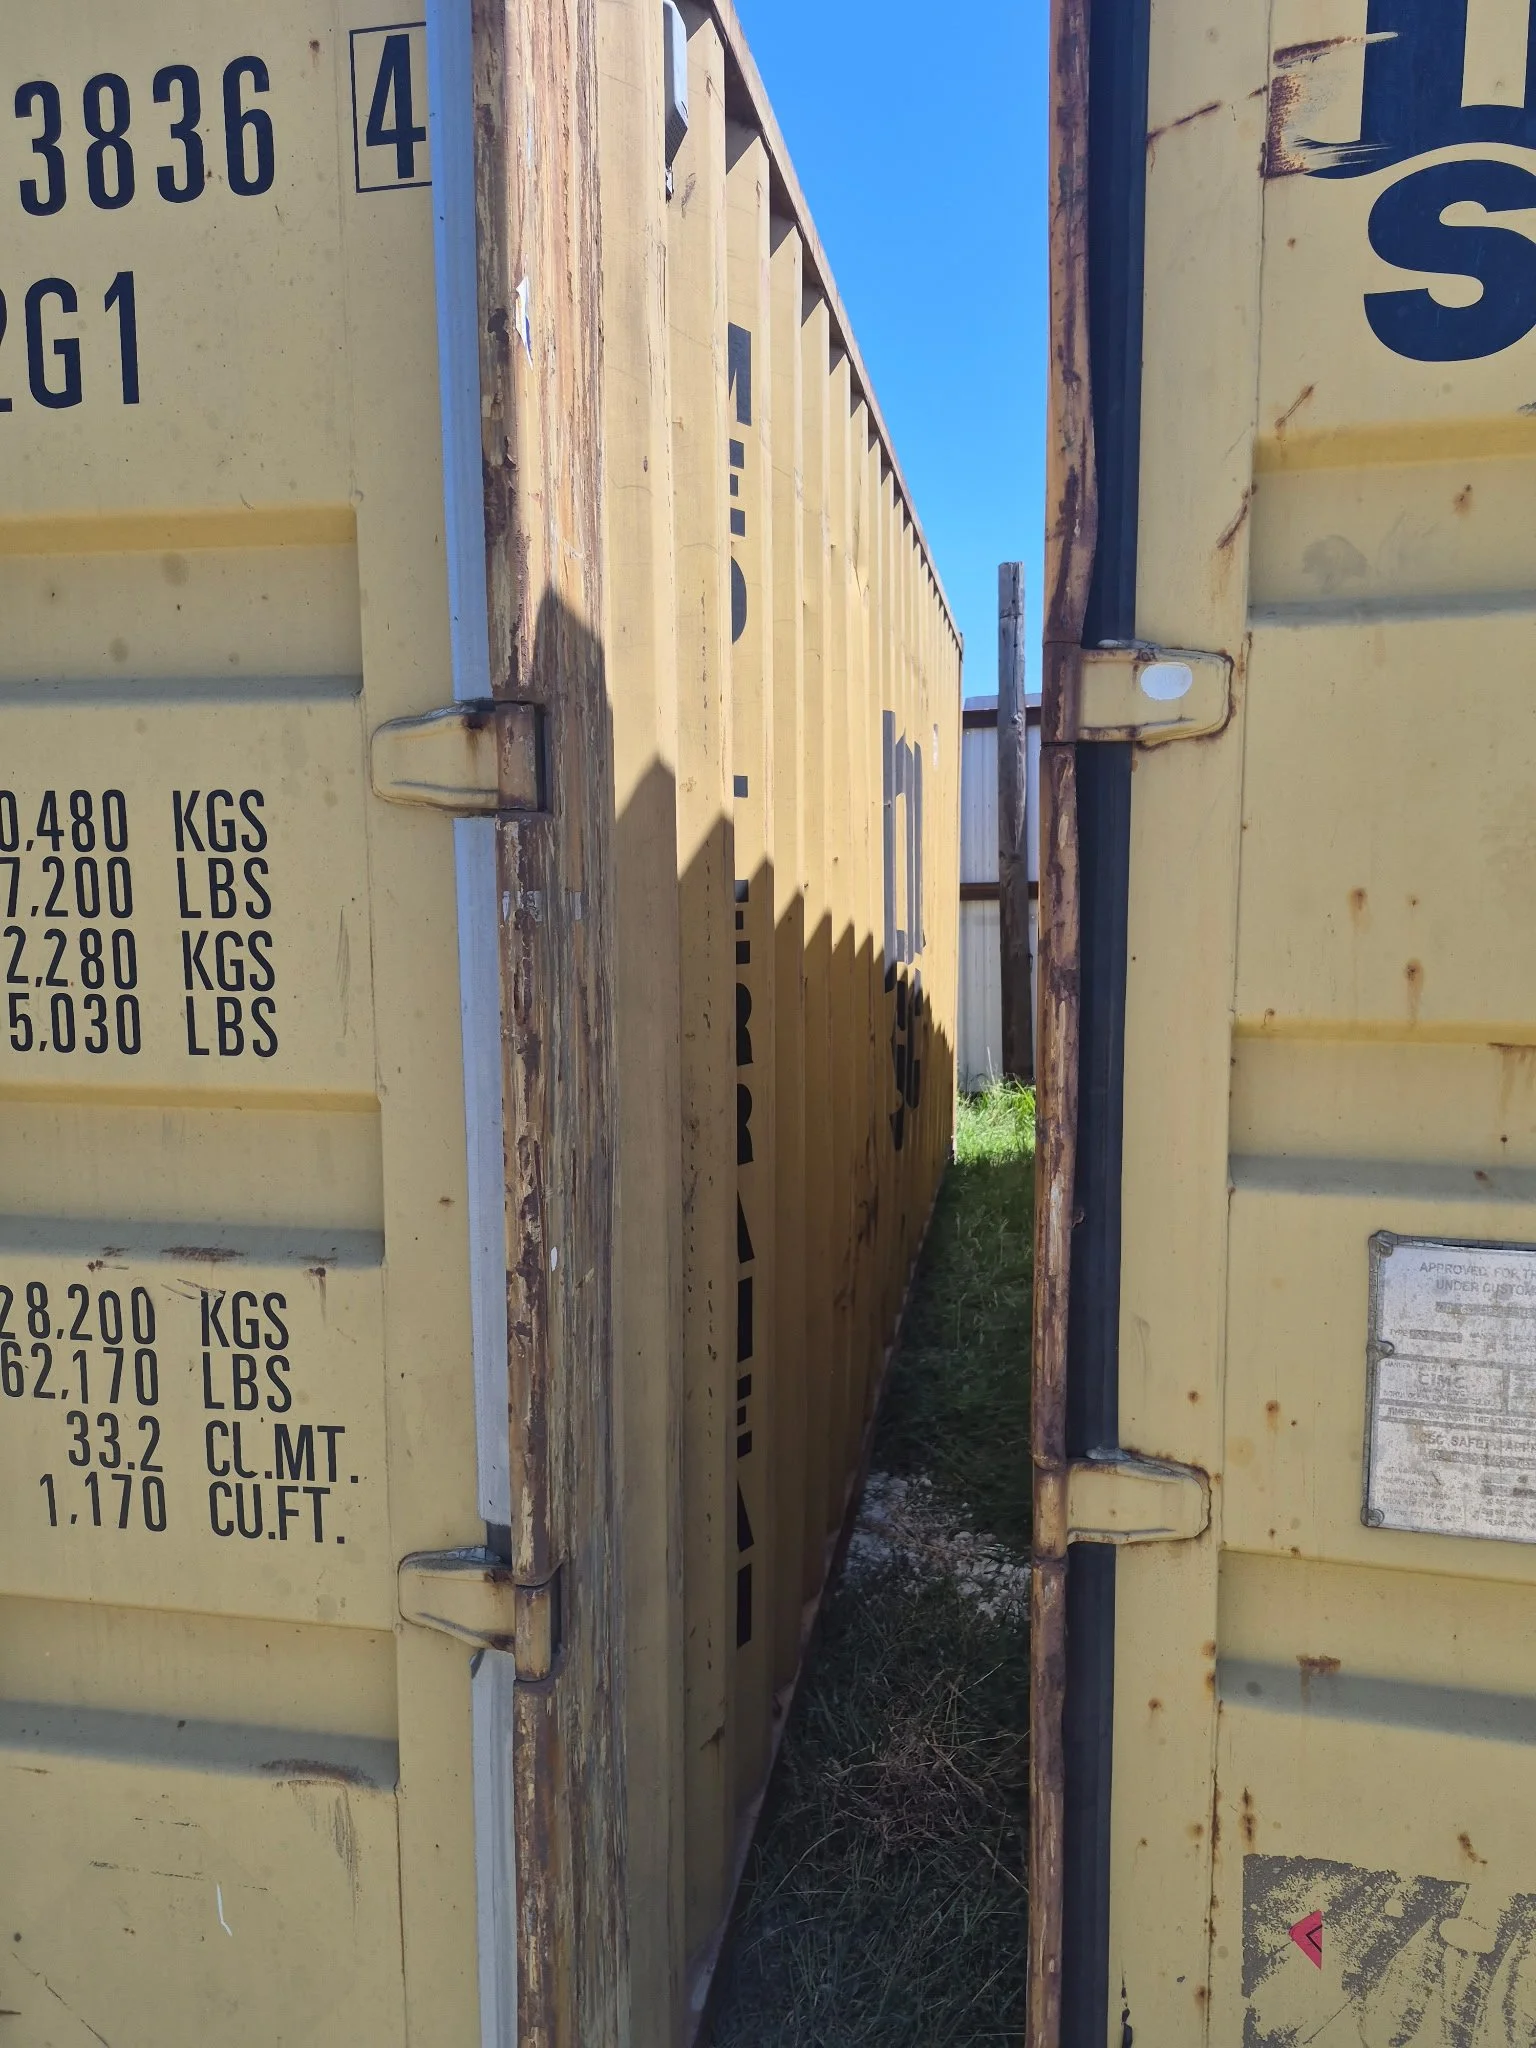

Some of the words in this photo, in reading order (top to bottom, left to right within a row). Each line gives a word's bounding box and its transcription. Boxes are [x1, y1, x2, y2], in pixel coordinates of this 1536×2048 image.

[15, 56, 274, 216] 3836
[366, 34, 426, 179] 4
[173, 790, 267, 852] KGS
[0, 856, 133, 918] 7,200
[177, 857, 271, 919] LBS
[4, 926, 137, 989] 2,280
[182, 930, 275, 991] KGS
[9, 993, 140, 1055] 5,030
[186, 996, 278, 1057] LBS
[1419, 1261, 1487, 1277] APPROVED
[1494, 1267, 1520, 1281] FOR
[1436, 1279, 1479, 1292] UNDER
[201, 1290, 288, 1350] KGS
[1, 1341, 158, 1405] 62,170
[203, 1352, 291, 1412] LBS
[67, 1411, 162, 1472] 33.2
[40, 1472, 166, 1531] 1,170
[209, 1481, 344, 1544] CU.FT.
